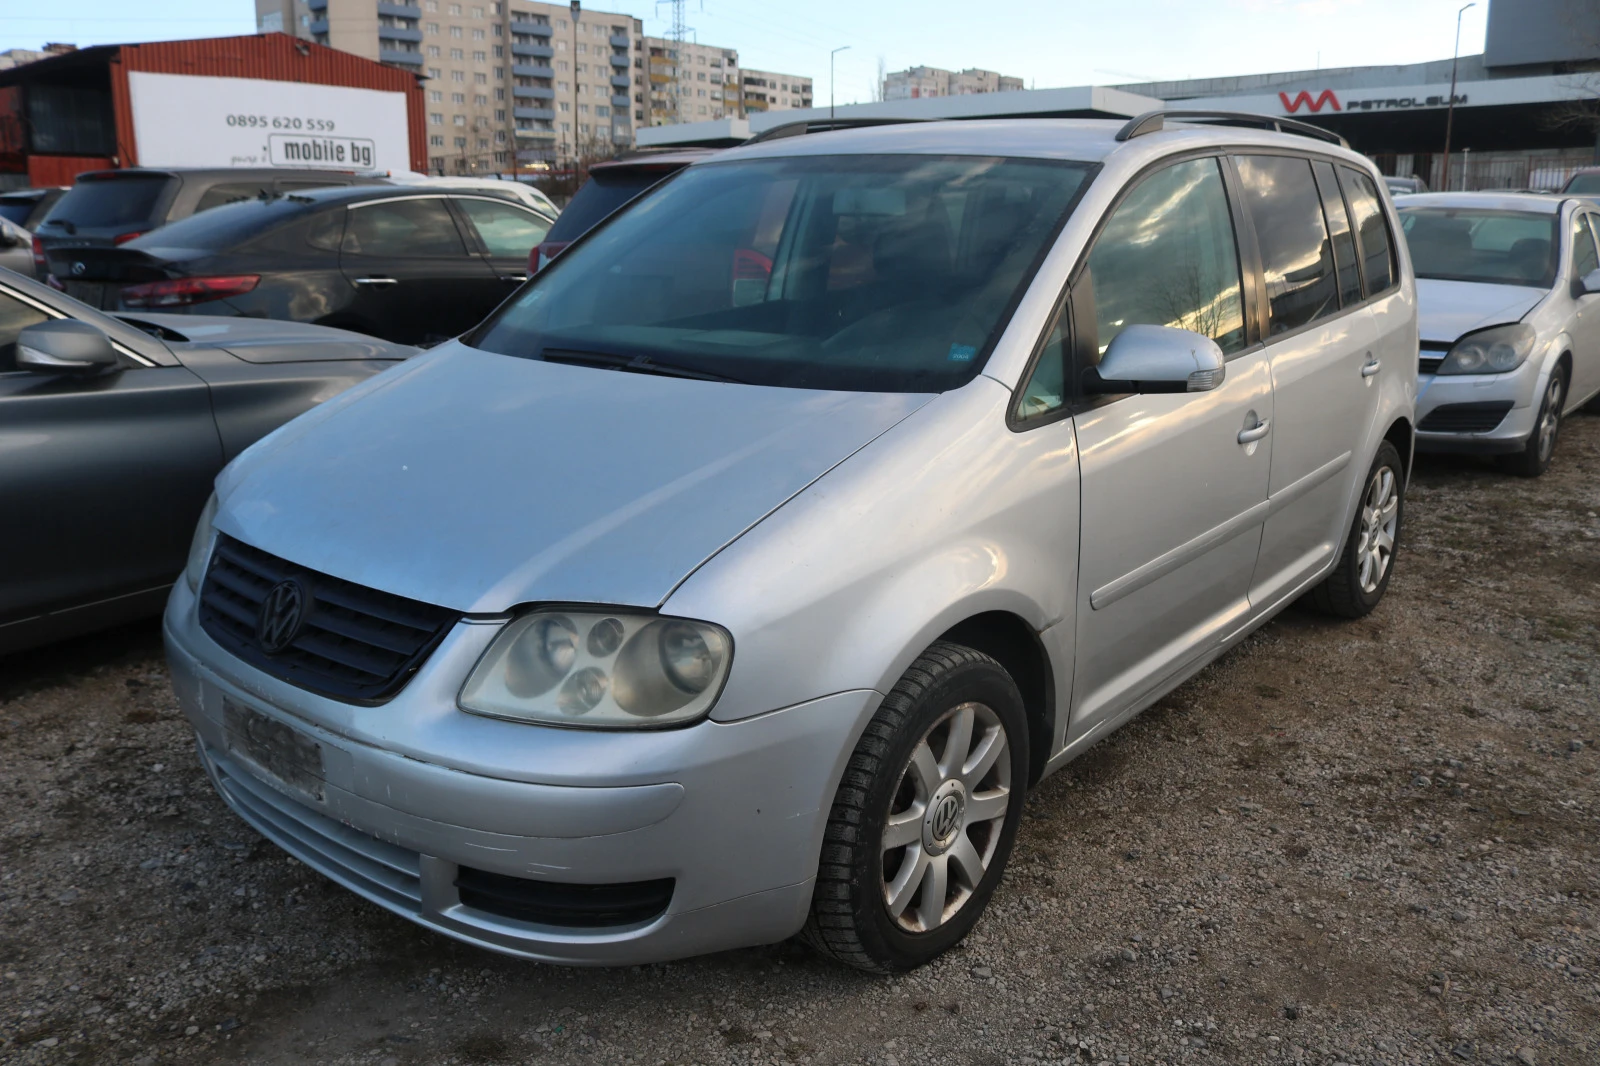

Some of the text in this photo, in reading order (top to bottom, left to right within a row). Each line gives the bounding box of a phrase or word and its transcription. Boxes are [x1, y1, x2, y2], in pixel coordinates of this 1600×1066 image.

[1347, 94, 1468, 111] PETROLEUM
[226, 114, 335, 132] 0895 620 559
